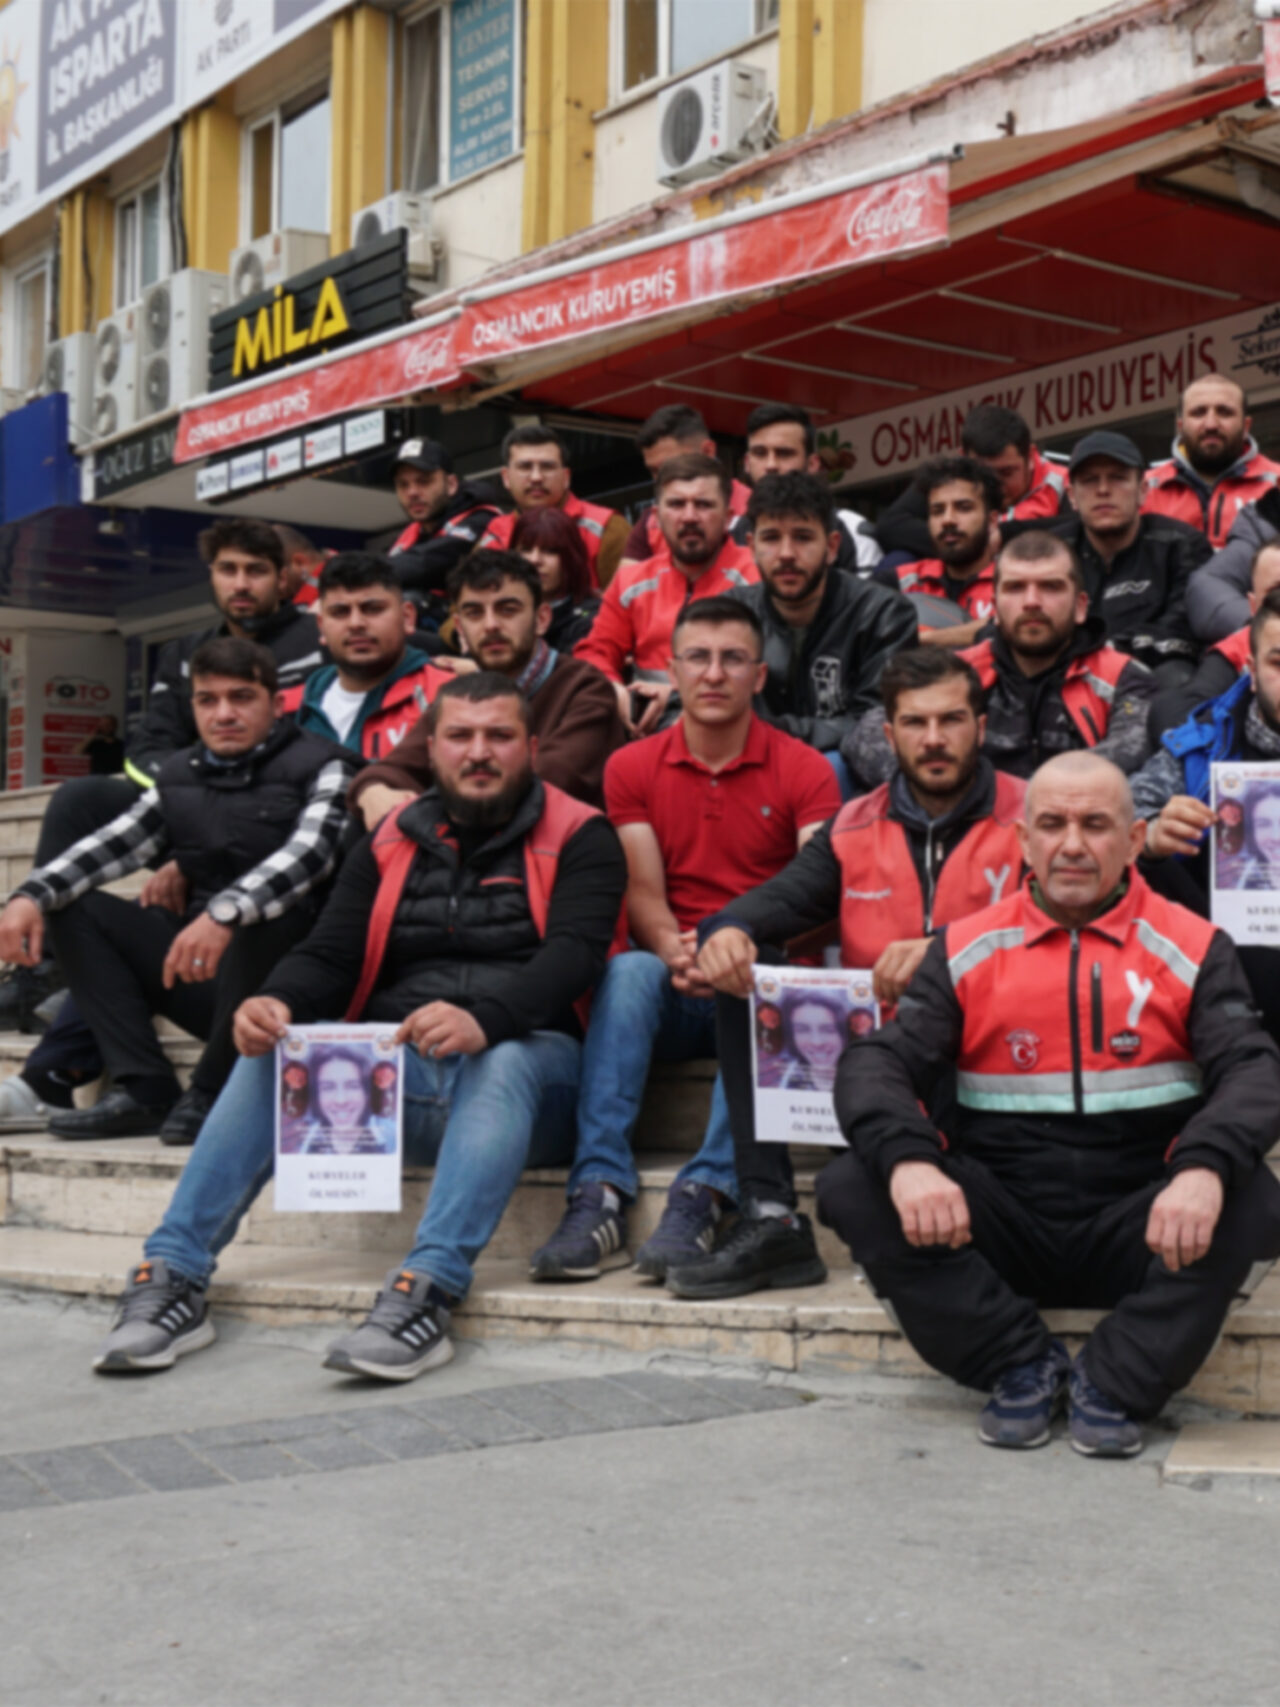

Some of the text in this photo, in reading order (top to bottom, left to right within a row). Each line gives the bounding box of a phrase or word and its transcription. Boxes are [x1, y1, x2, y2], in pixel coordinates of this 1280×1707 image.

[49, 0, 164, 116] ISPARTA
[47, 55, 164, 166] İL BAŞKANLIĞI
[232, 277, 349, 378] MİLA
[472, 266, 677, 348] OSMANCIK KURUYEMİŞ
[871, 386, 1025, 467] OSMAN
